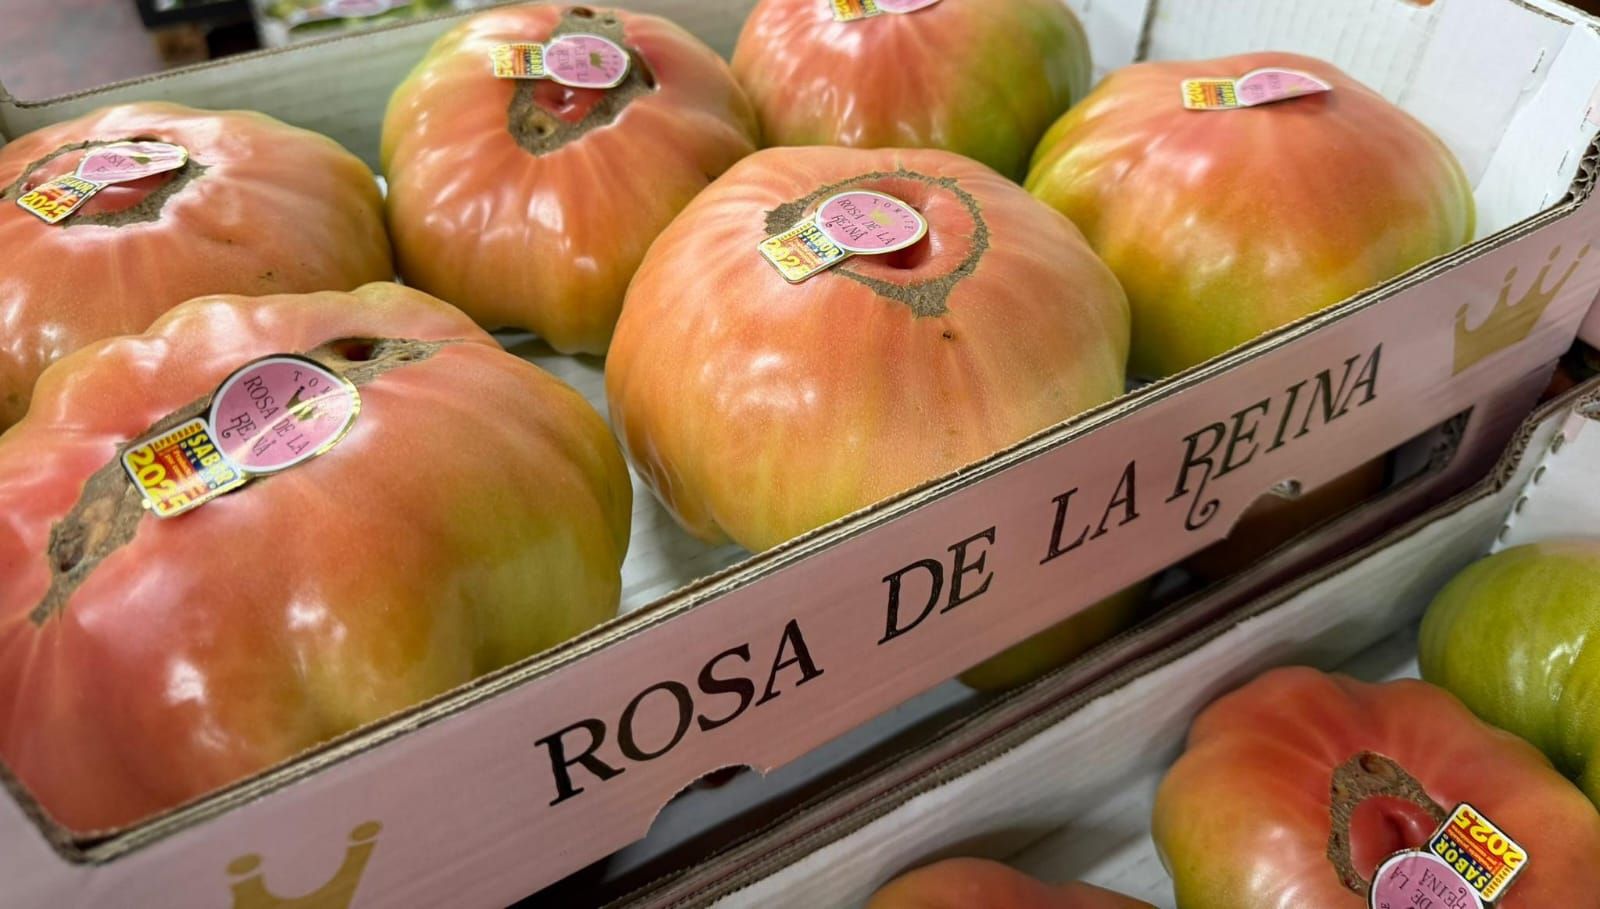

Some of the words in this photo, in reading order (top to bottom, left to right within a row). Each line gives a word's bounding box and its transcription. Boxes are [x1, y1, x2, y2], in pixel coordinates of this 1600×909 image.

[23, 191, 67, 218] 2025
[838, 199, 865, 222] ROSA
[862, 220, 881, 231] DE
[877, 232, 896, 245] LA
[804, 227, 840, 258] SABOR
[826, 214, 869, 242] REINA
[243, 375, 279, 420] ROSA
[271, 418, 296, 438] DE
[286, 433, 311, 456] LA
[126, 446, 189, 511] 2025
[533, 620, 825, 807] ROSA
[878, 526, 998, 648] DE
[1039, 459, 1140, 566] LA
[1165, 341, 1385, 532] REINA
[1454, 807, 1524, 871] 2025
[1389, 866, 1410, 890] LA
[1435, 837, 1488, 890] SABOR
[1410, 888, 1434, 909] DE
